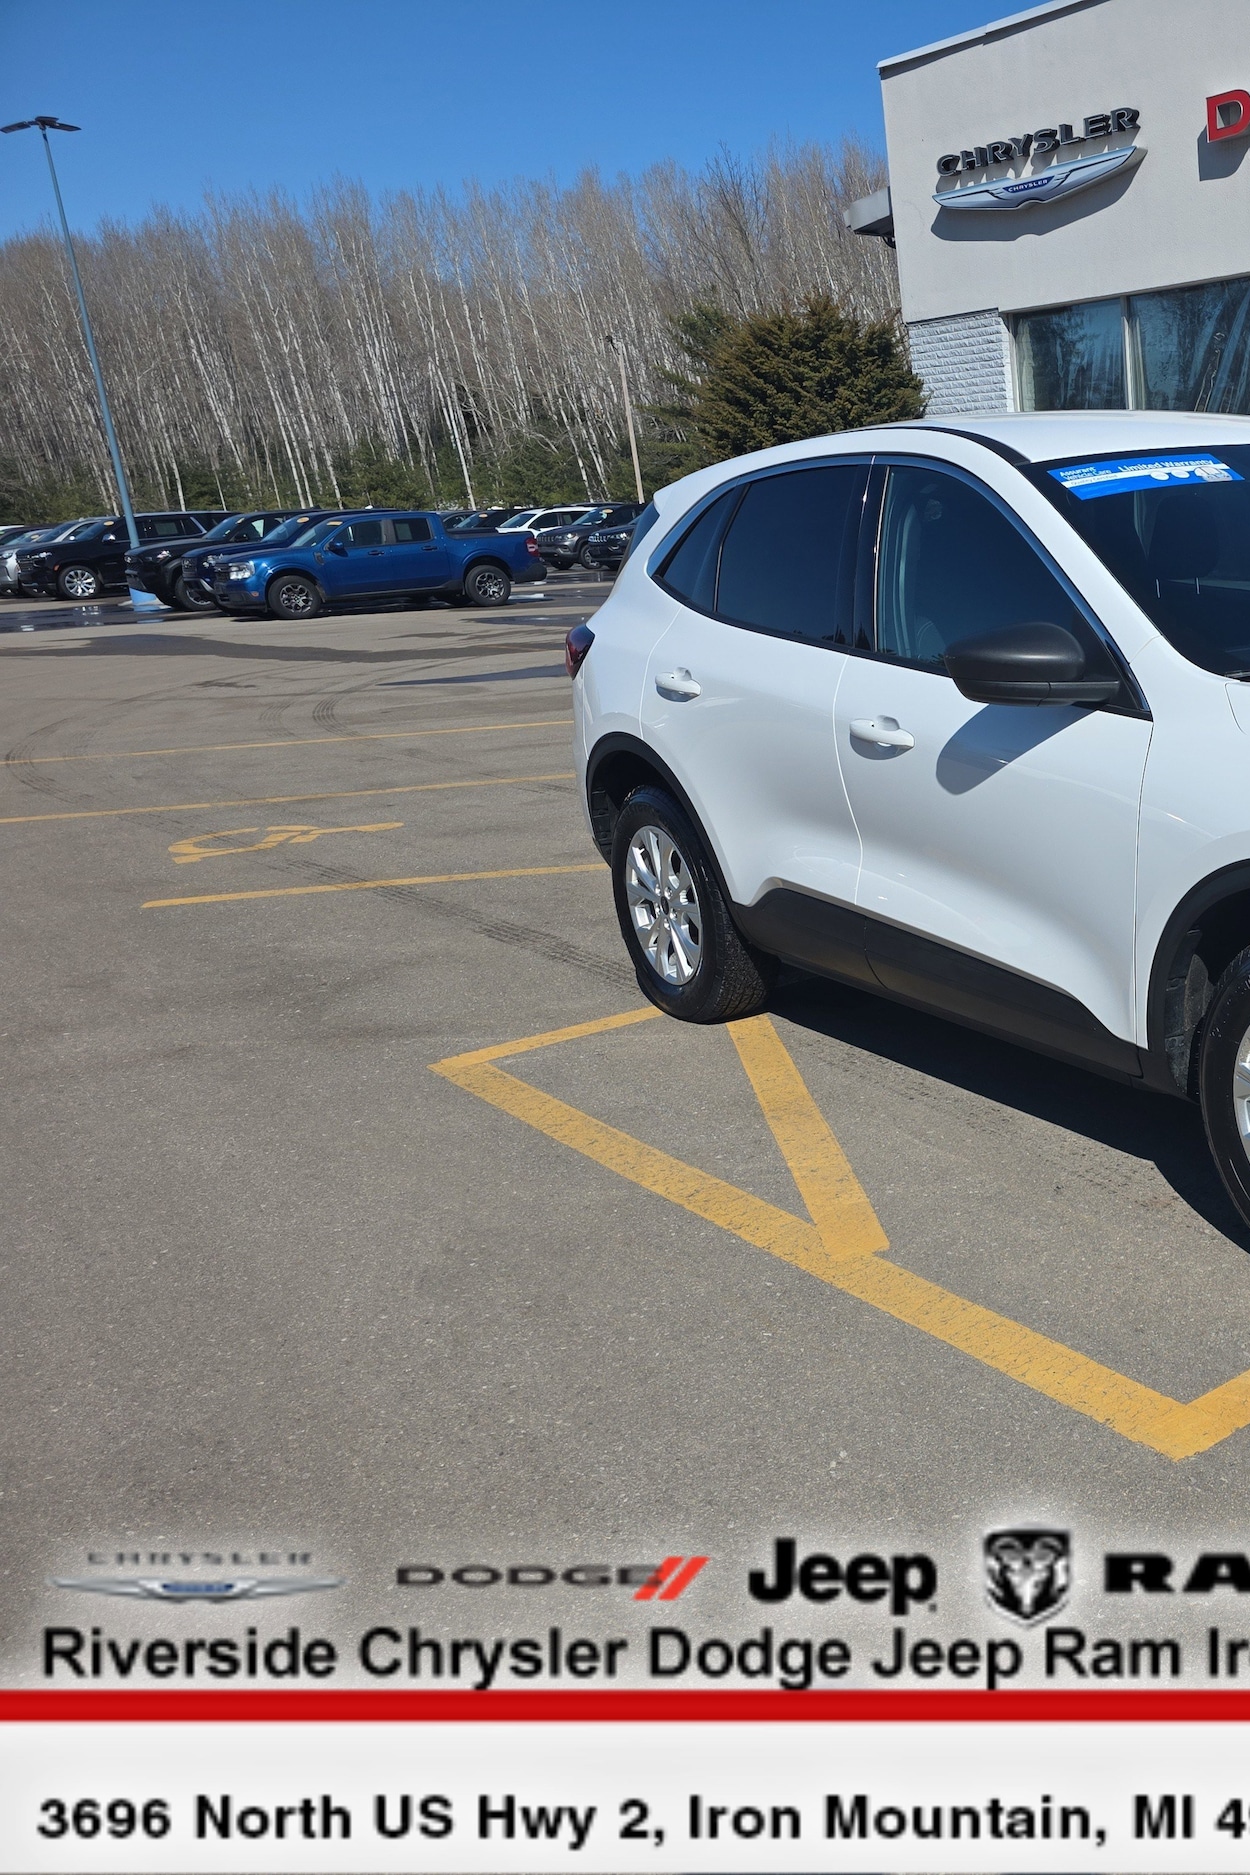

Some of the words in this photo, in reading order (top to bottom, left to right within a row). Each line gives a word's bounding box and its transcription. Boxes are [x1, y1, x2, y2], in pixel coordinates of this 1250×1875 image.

[936, 107, 1140, 177] CHRYSLER
[1008, 179, 1048, 192] CHRYSLER
[1117, 462, 1162, 473] Limited
[1161, 459, 1214, 468] Warranty
